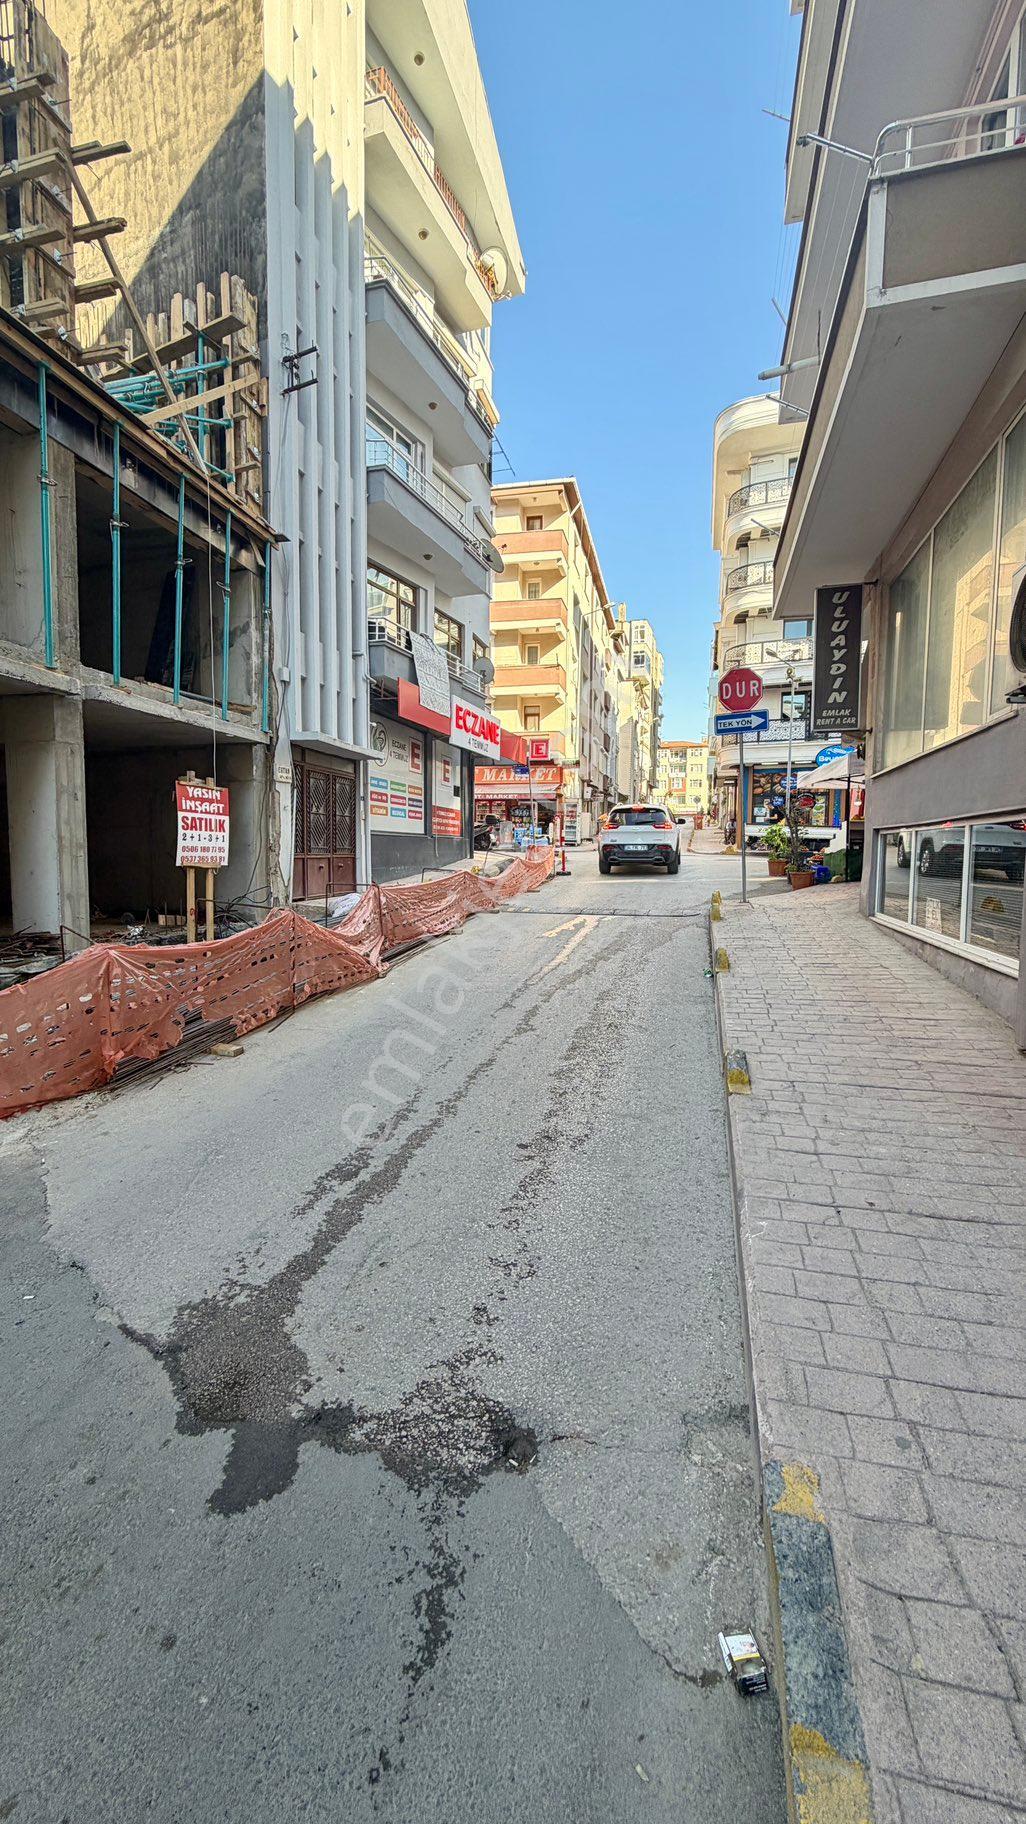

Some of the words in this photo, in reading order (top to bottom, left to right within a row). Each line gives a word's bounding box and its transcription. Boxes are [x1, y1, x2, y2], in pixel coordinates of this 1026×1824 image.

[827, 591, 849, 704] ULUAYDIN
[722, 680, 759, 700] DUR
[822, 709, 851, 717] EMLAK
[455, 703, 499, 746] ECZANE
[816, 718, 835, 726] RENT
[411, 741, 421, 771] E
[535, 743, 545, 755] E
[443, 759, 450, 783] E
[186, 786, 221, 800] YASIN
[182, 797, 225, 814] İNŞAAT
[181, 815, 226, 833] SATILIK
[182, 832, 187, 841] 2
[197, 833, 201, 842] 1
[208, 834, 213, 843] 3
